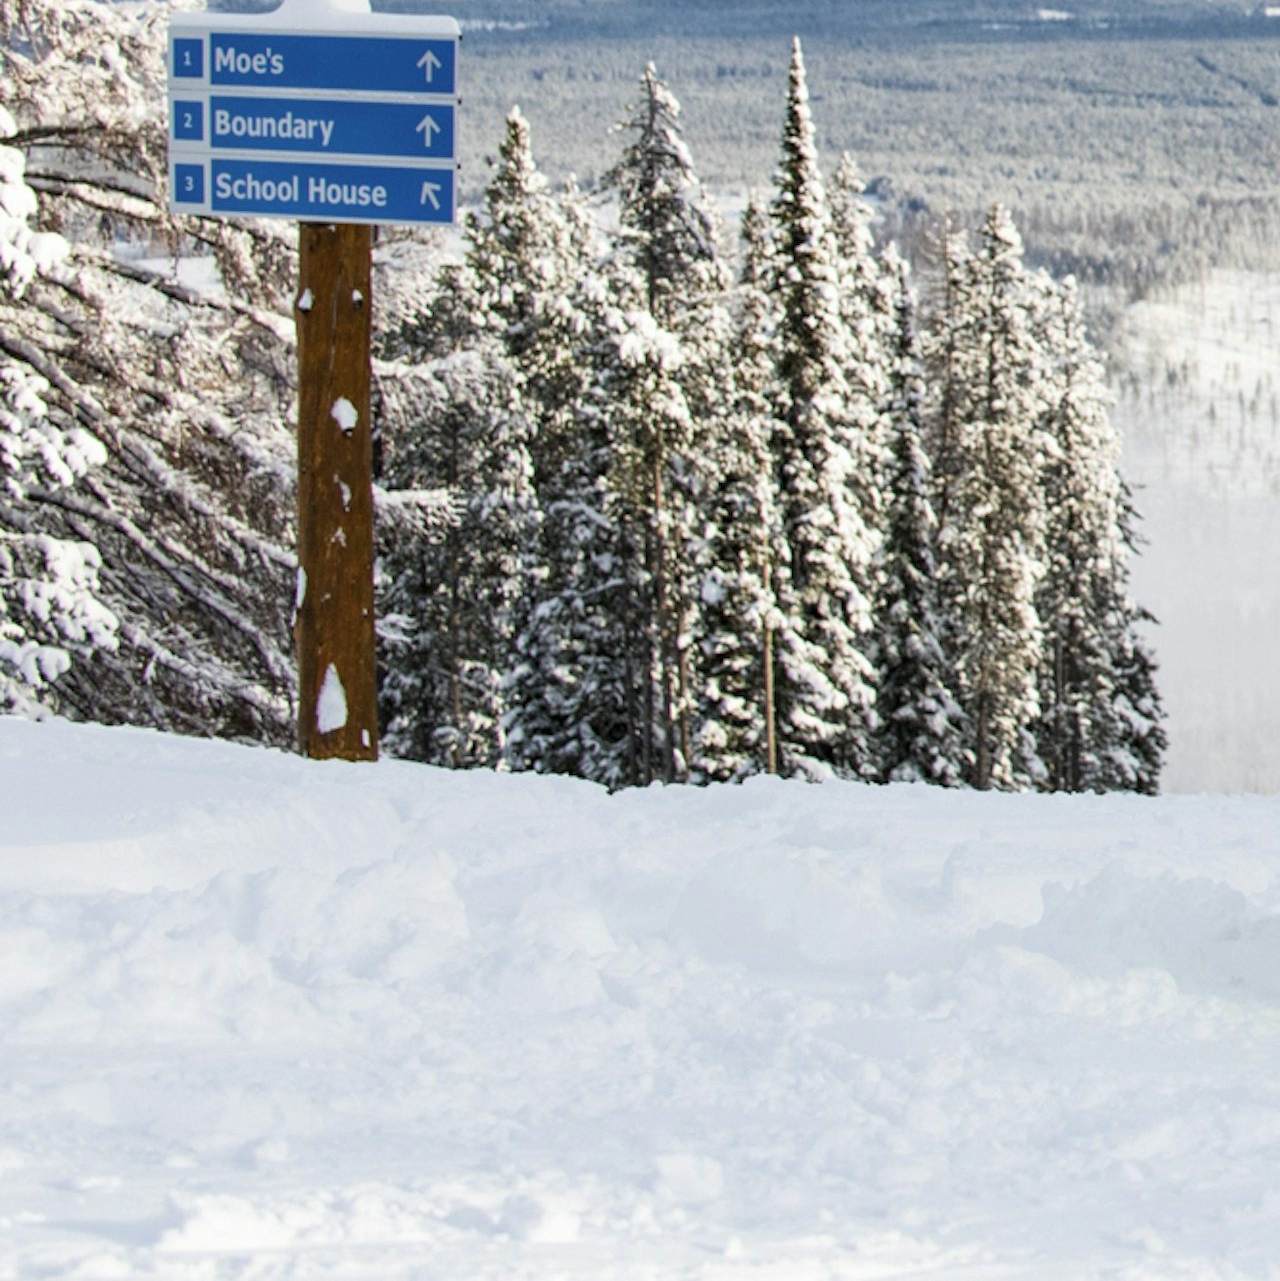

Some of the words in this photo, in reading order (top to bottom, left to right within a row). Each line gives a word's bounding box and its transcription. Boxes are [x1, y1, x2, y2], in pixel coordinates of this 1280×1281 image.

[184, 51, 192, 66] 1
[214, 47, 284, 75] Moe's
[184, 113, 193, 128] 2
[214, 109, 334, 147] Boundary
[185, 176, 194, 192] 3
[215, 172, 299, 203] School
[307, 177, 387, 207] House
